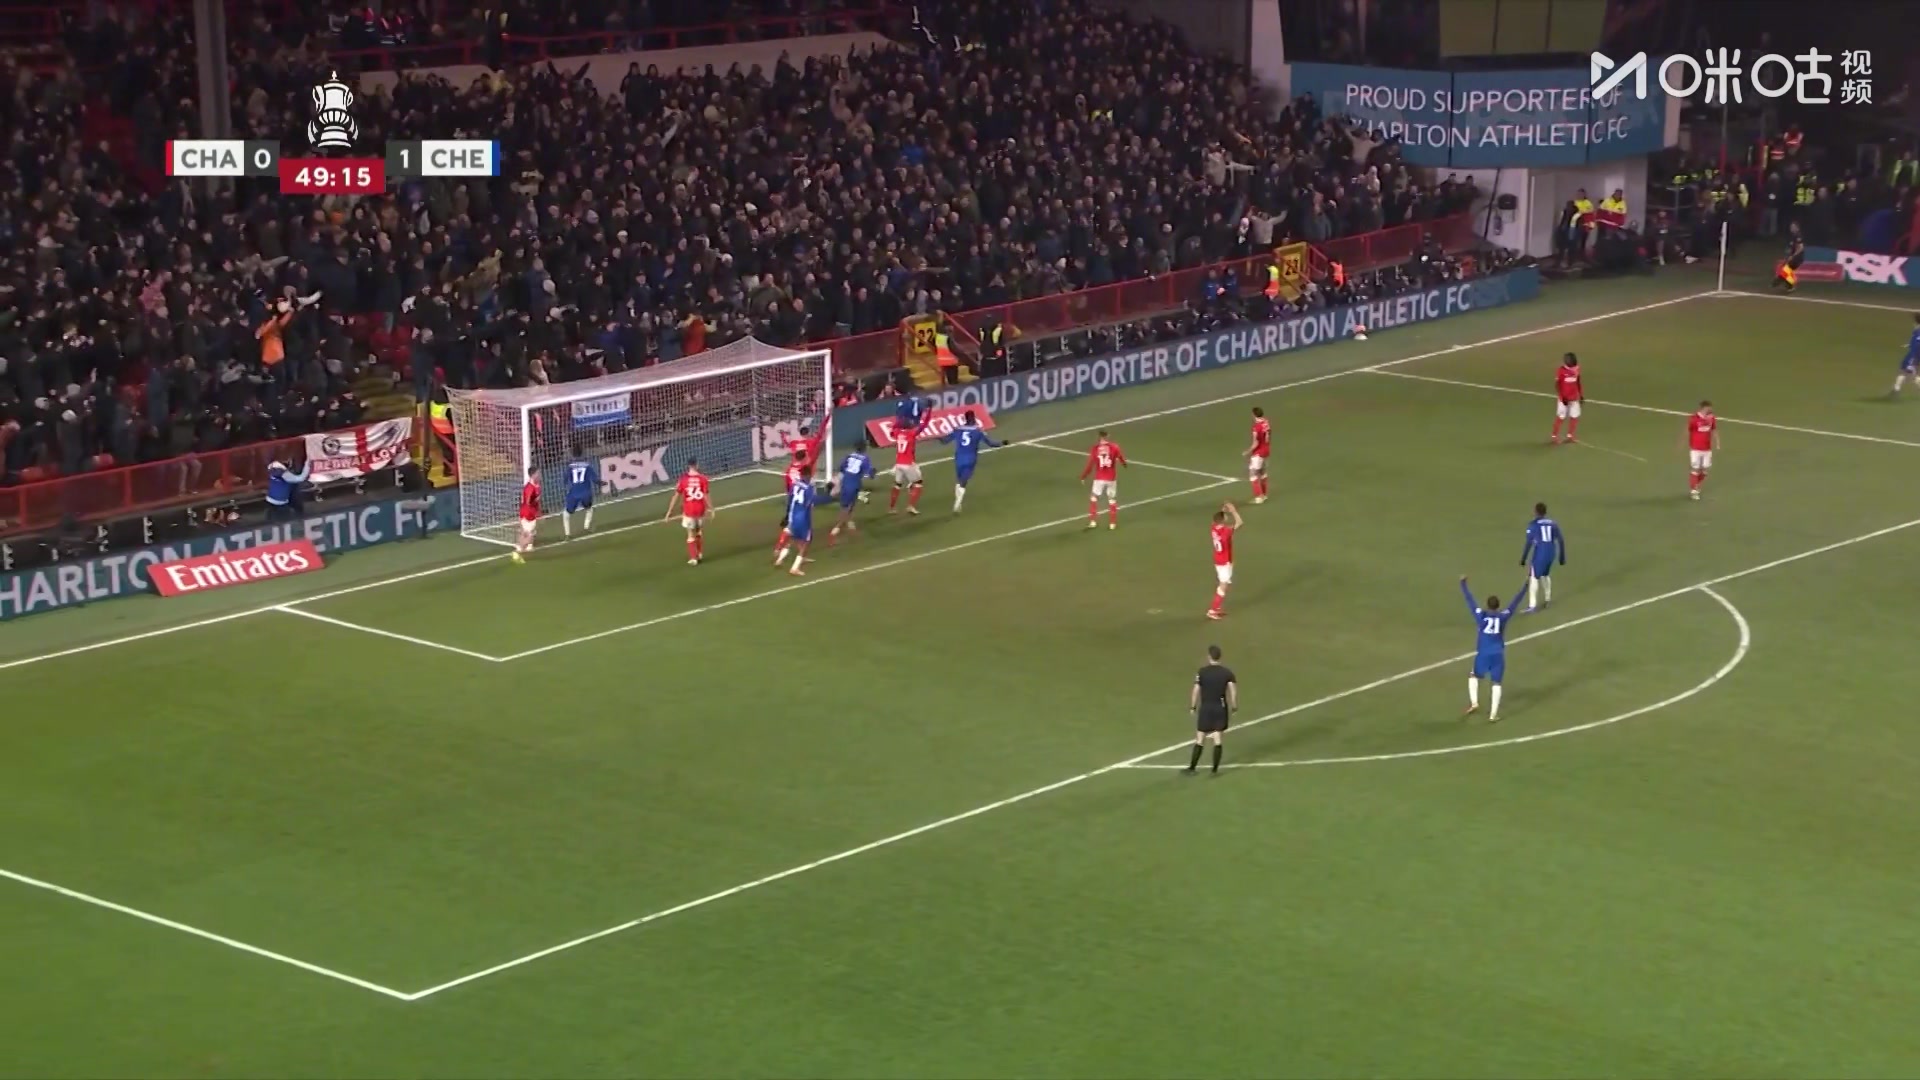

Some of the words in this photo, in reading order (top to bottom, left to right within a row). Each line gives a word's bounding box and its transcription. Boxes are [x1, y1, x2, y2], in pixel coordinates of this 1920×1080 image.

[1346, 84, 1426, 111] PROUD
[1433, 87, 1596, 113] SUPPORTER
[1478, 120, 1604, 148] ATHLETIC
[1607, 115, 1629, 140] FC
[1836, 250, 1909, 287] RSK
[1027, 350, 1168, 405] SUPPORTER
[1176, 338, 1208, 373] OF
[1214, 317, 1336, 365] CHARLTON
[1341, 290, 1440, 337] ATHLETIC
[1446, 283, 1471, 315] FC
[961, 431, 971, 447] 5
[572, 467, 587, 484] 17
[600, 443, 670, 494] RSK
[685, 486, 704, 502] 36
[1540, 525, 1552, 542] 11
[165, 548, 309, 592] Emirates
[1483, 617, 1501, 634] 21
